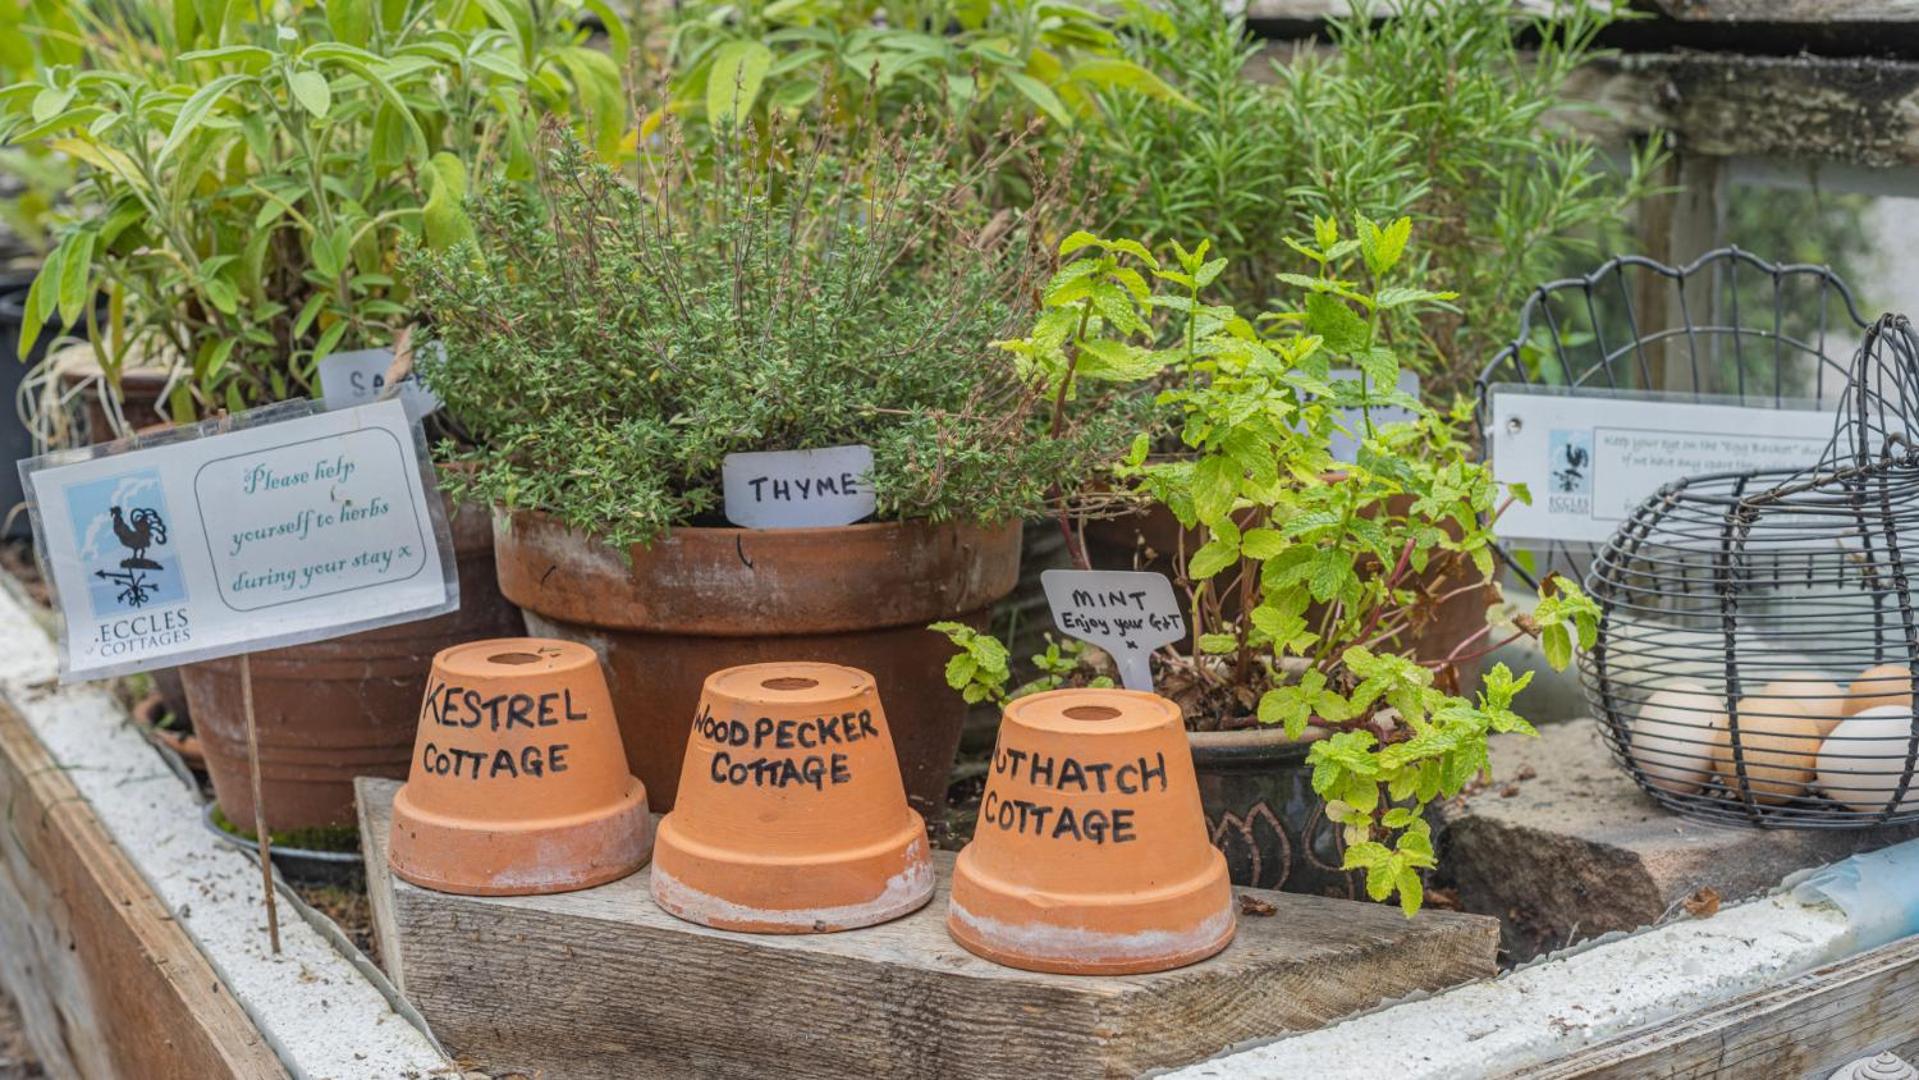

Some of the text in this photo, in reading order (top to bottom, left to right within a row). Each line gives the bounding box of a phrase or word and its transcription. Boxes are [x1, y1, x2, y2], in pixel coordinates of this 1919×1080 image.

[244, 455, 355, 494] Please help
[748, 472, 857, 502] THYME
[229, 497, 389, 557] yourself to herbs
[232, 544, 413, 593] during your stay x
[1072, 589, 1147, 611] MINT
[100, 608, 189, 643] ECCLES
[100, 628, 191, 657] COTTAGES
[1061, 612, 1110, 635] Enjoy
[1114, 618, 1144, 637] your
[422, 676, 588, 732] KESTREL
[711, 751, 851, 791] COTTAGE
[994, 747, 1168, 794] UTHATCH
[984, 790, 1137, 844] COTTAGE
